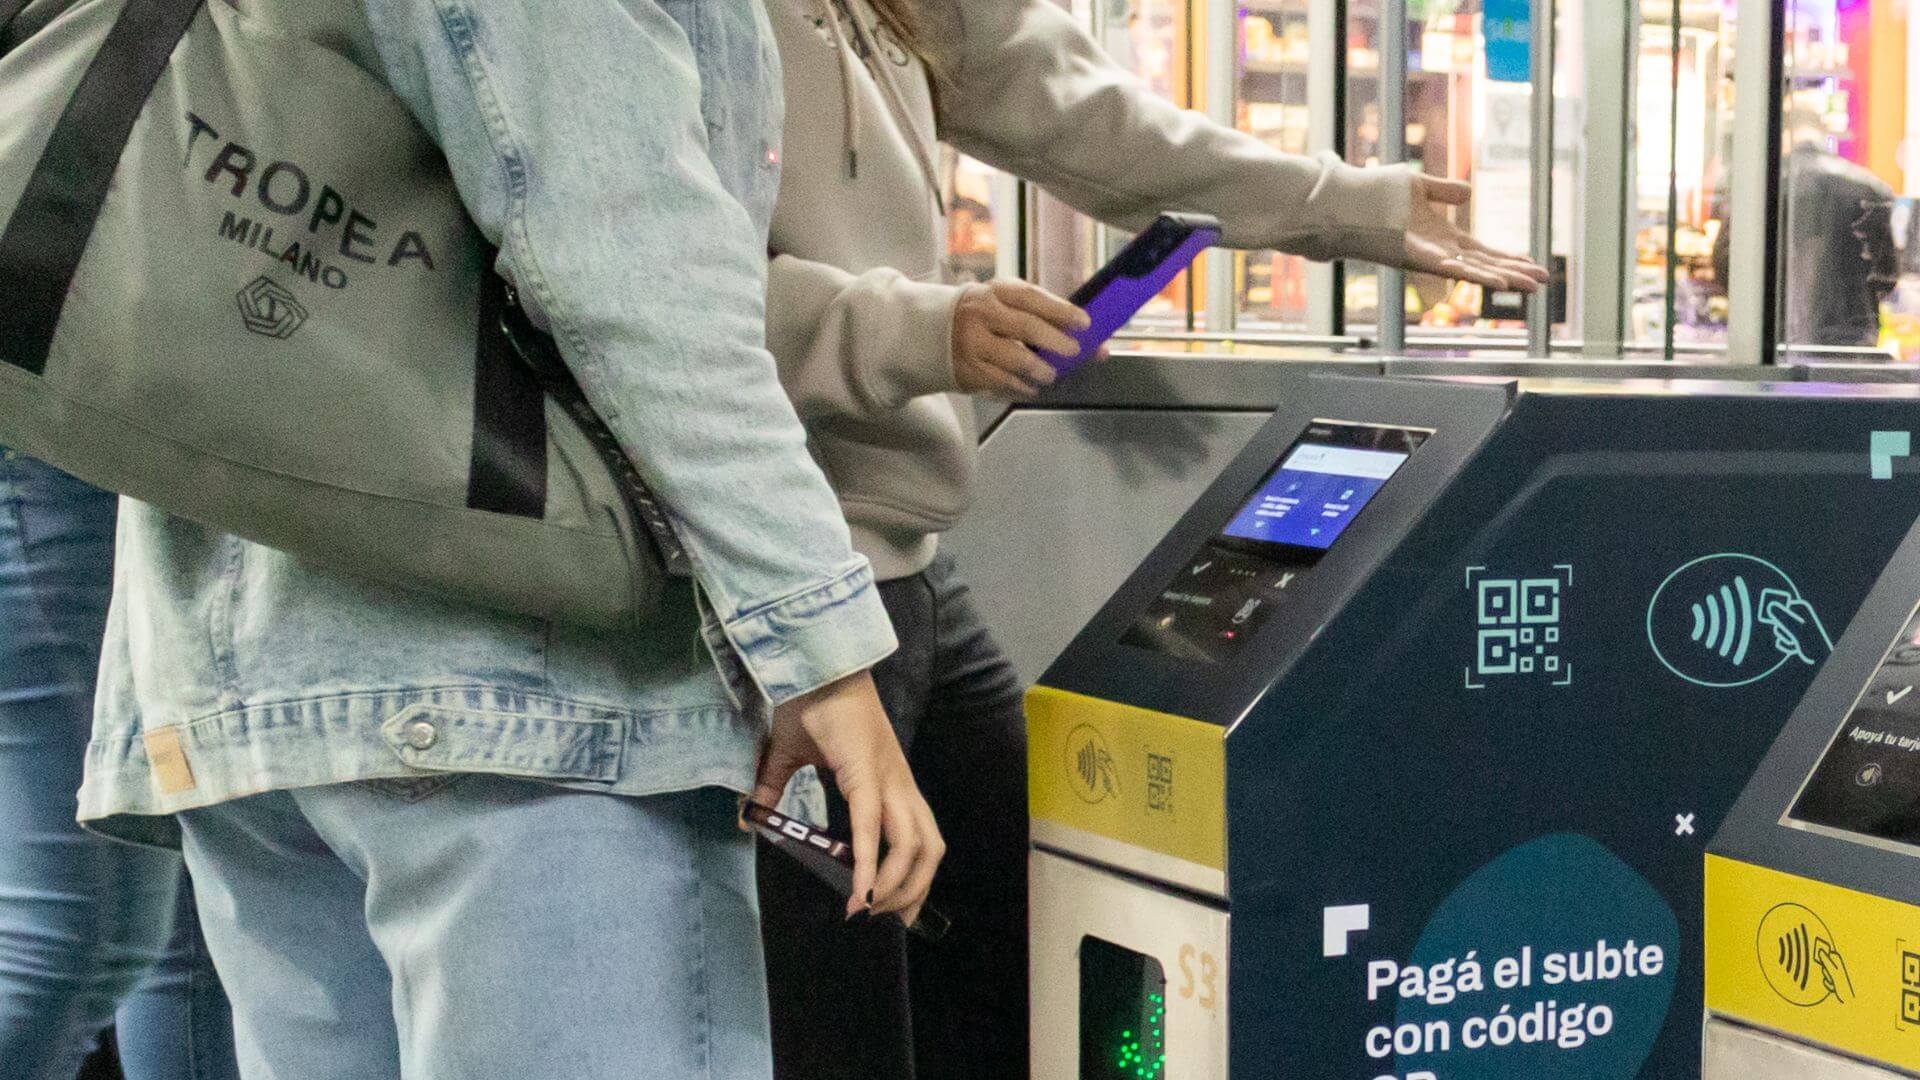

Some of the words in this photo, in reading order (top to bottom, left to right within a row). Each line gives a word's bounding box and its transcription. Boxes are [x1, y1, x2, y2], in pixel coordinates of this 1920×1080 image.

[183, 111, 435, 270] TROPEA
[218, 210, 348, 290] MILANO
[1849, 726, 1884, 744] Apoyá
[1885, 734, 1897, 745] tu
[1178, 943, 1218, 1009] S3
[1367, 951, 1484, 1005] Pagá
[1493, 946, 1531, 989] el
[1543, 940, 1664, 985] subte
[1365, 1020, 1450, 1058] con
[1461, 1000, 1613, 1049] código
